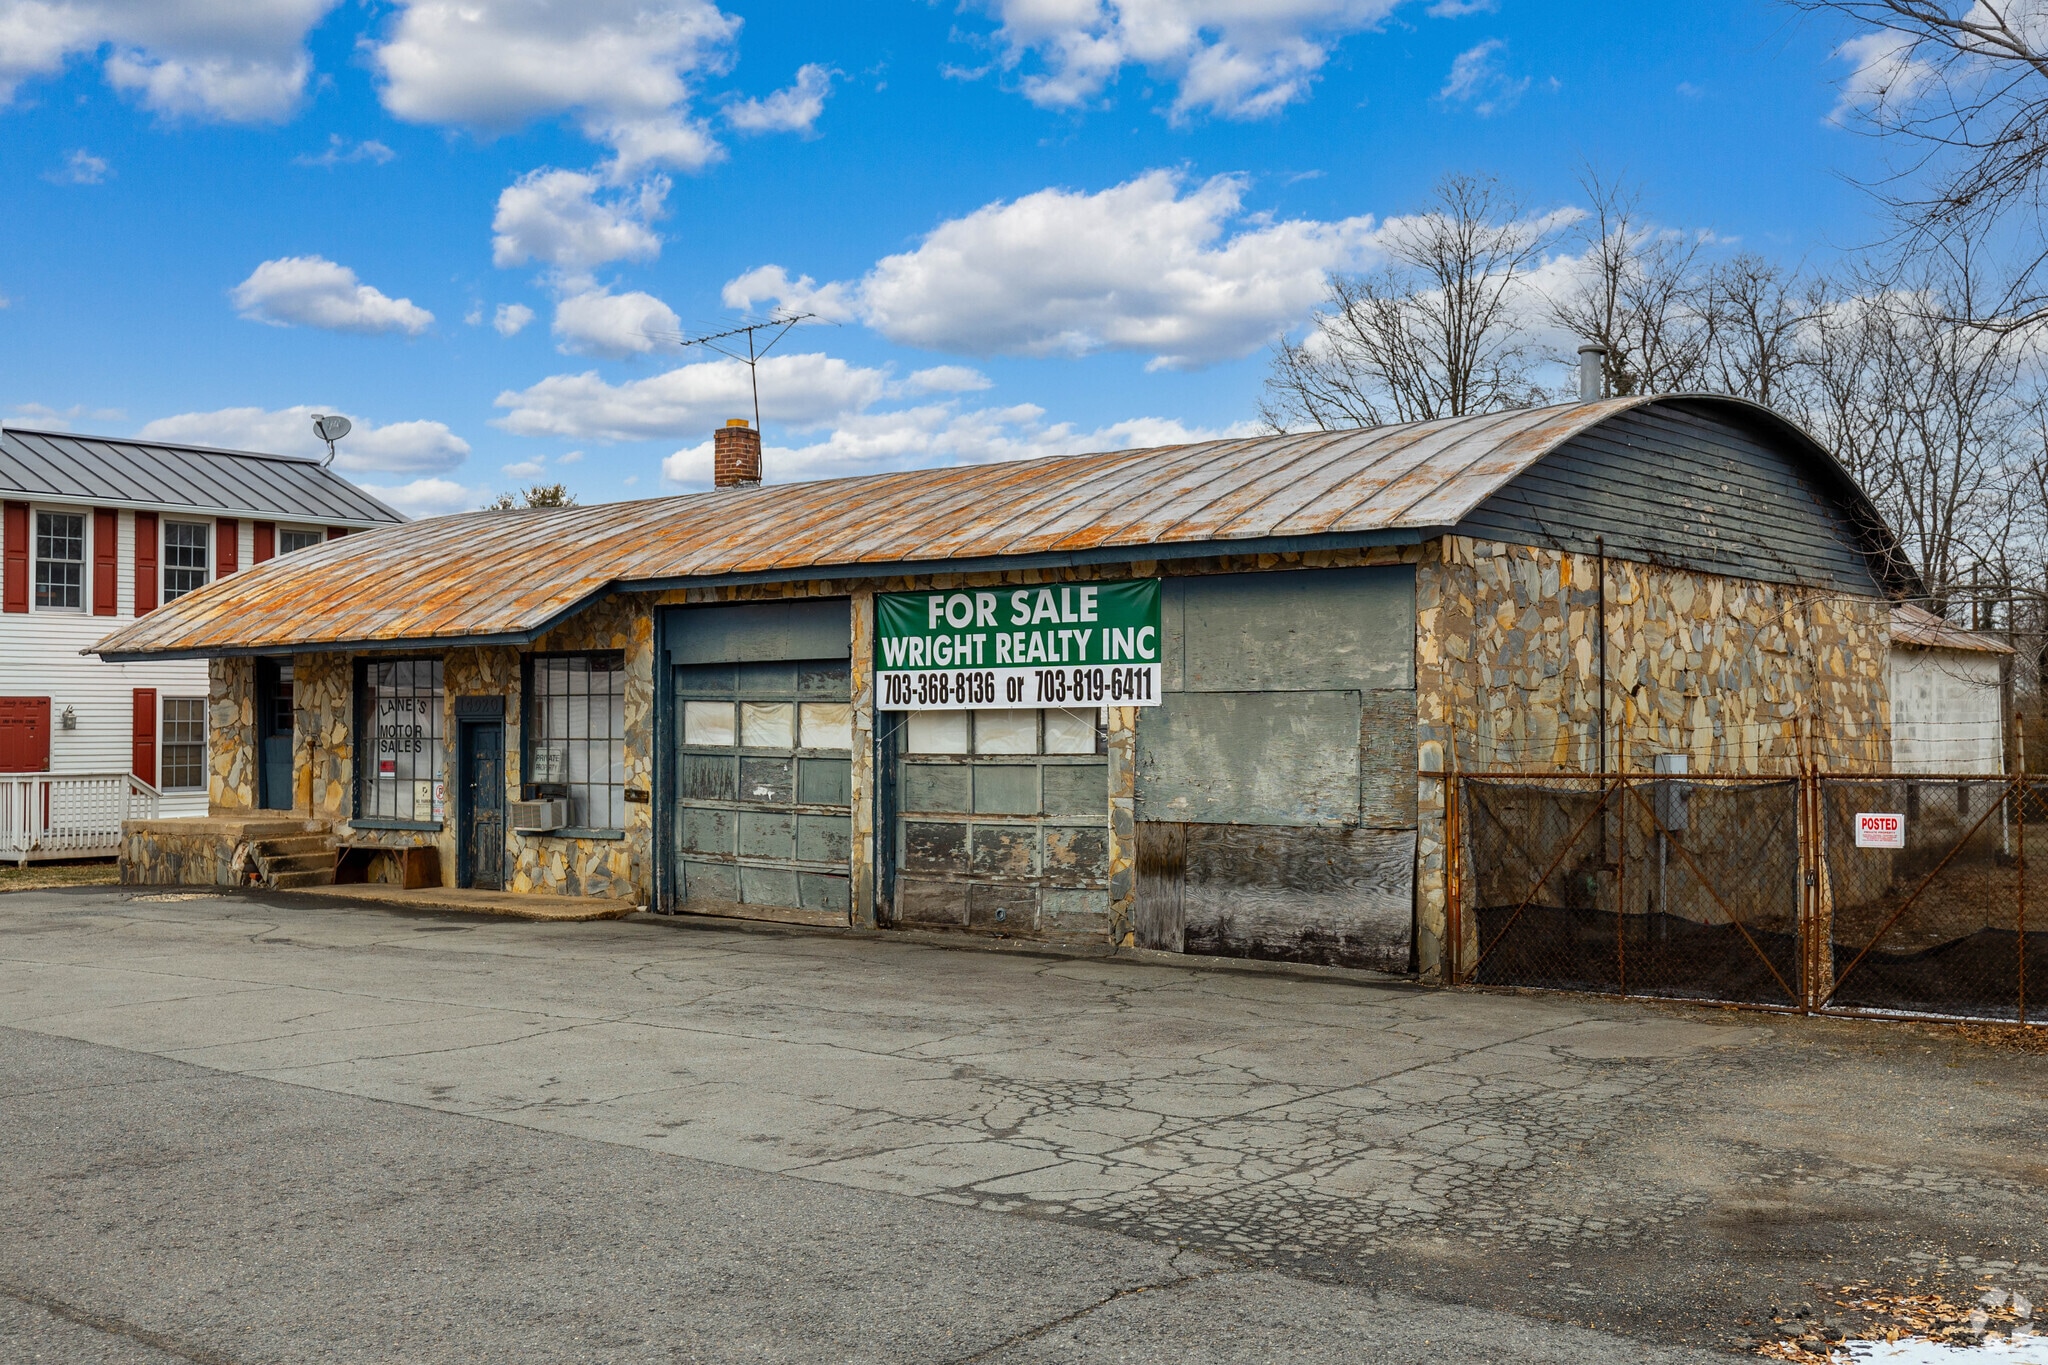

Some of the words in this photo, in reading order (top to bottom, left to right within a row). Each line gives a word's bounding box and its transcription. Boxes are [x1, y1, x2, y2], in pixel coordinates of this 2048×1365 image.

[928, 592, 998, 629] FOR
[1010, 586, 1098, 626] SALE
[881, 633, 987, 667] WRIGHT
[996, 629, 1093, 664] REALTY
[1102, 626, 1155, 660] INC
[884, 671, 995, 705] 703-368-8136
[1006, 675, 1025, 703] or
[1035, 667, 1152, 702] 703-819-6411
[380, 698, 427, 717] LANE'S
[380, 724, 422, 738] MOTOR
[380, 739, 422, 753] SALES
[536, 763, 559, 772] PROPRTY
[1861, 817, 1898, 830] POSTED
